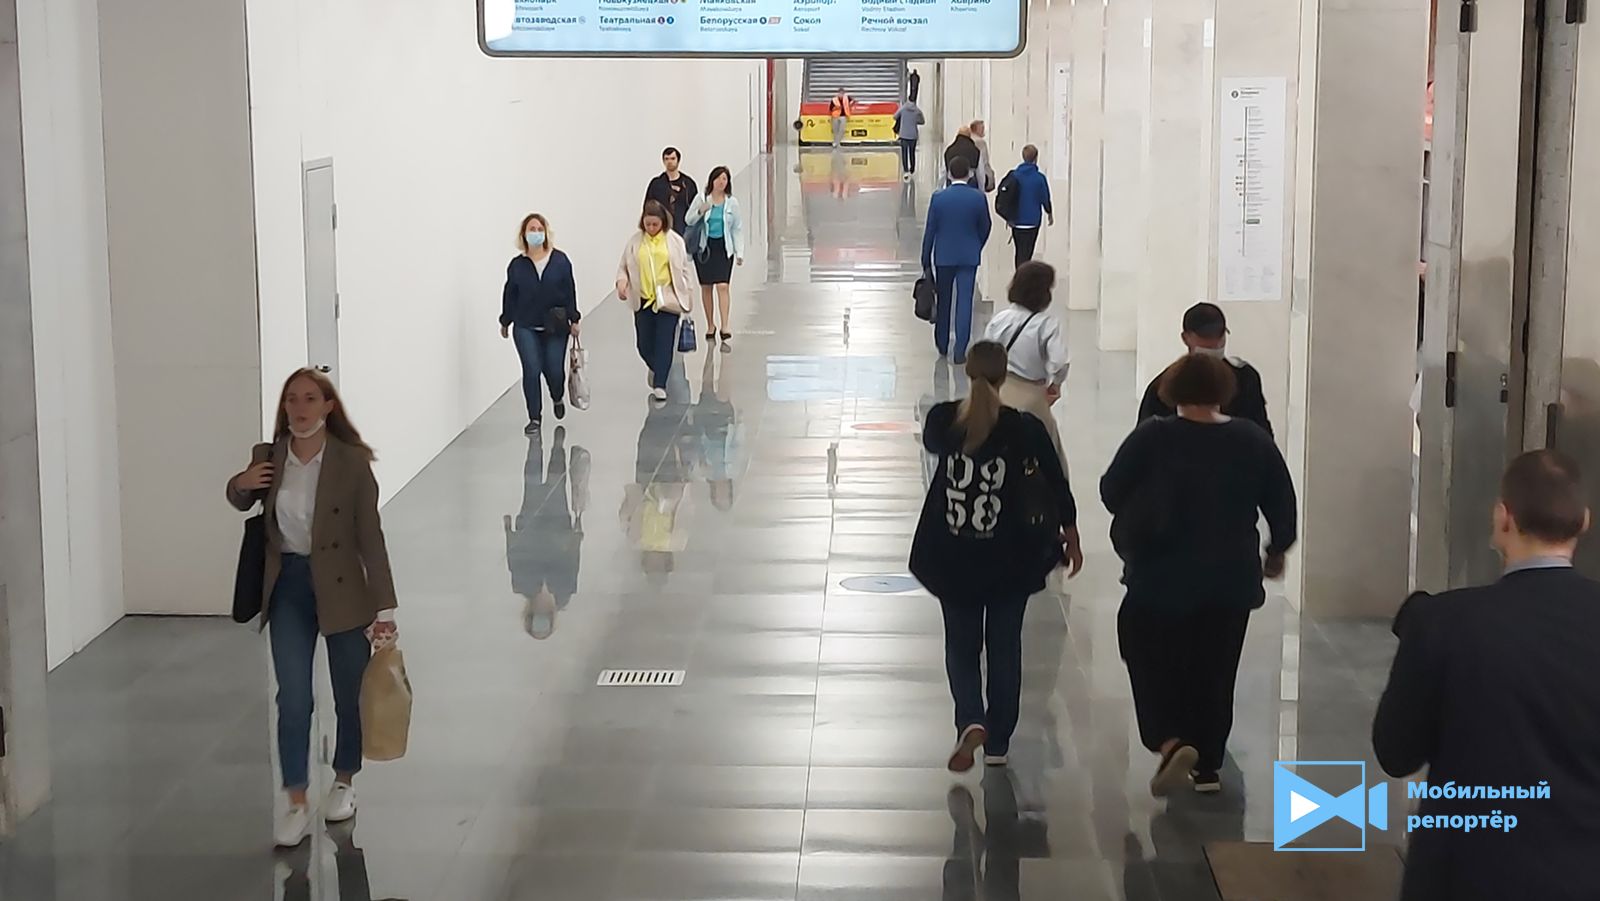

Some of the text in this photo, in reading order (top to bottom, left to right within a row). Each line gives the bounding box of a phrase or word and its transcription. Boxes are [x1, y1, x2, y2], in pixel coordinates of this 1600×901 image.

[515, 17, 577, 25] втозаводская
[600, 16, 656, 25] Театральная
[700, 16, 758, 26] Белорусская
[793, 16, 821, 24] Сокол
[861, 16, 895, 24] Речной
[946, 488, 1002, 532] 58
